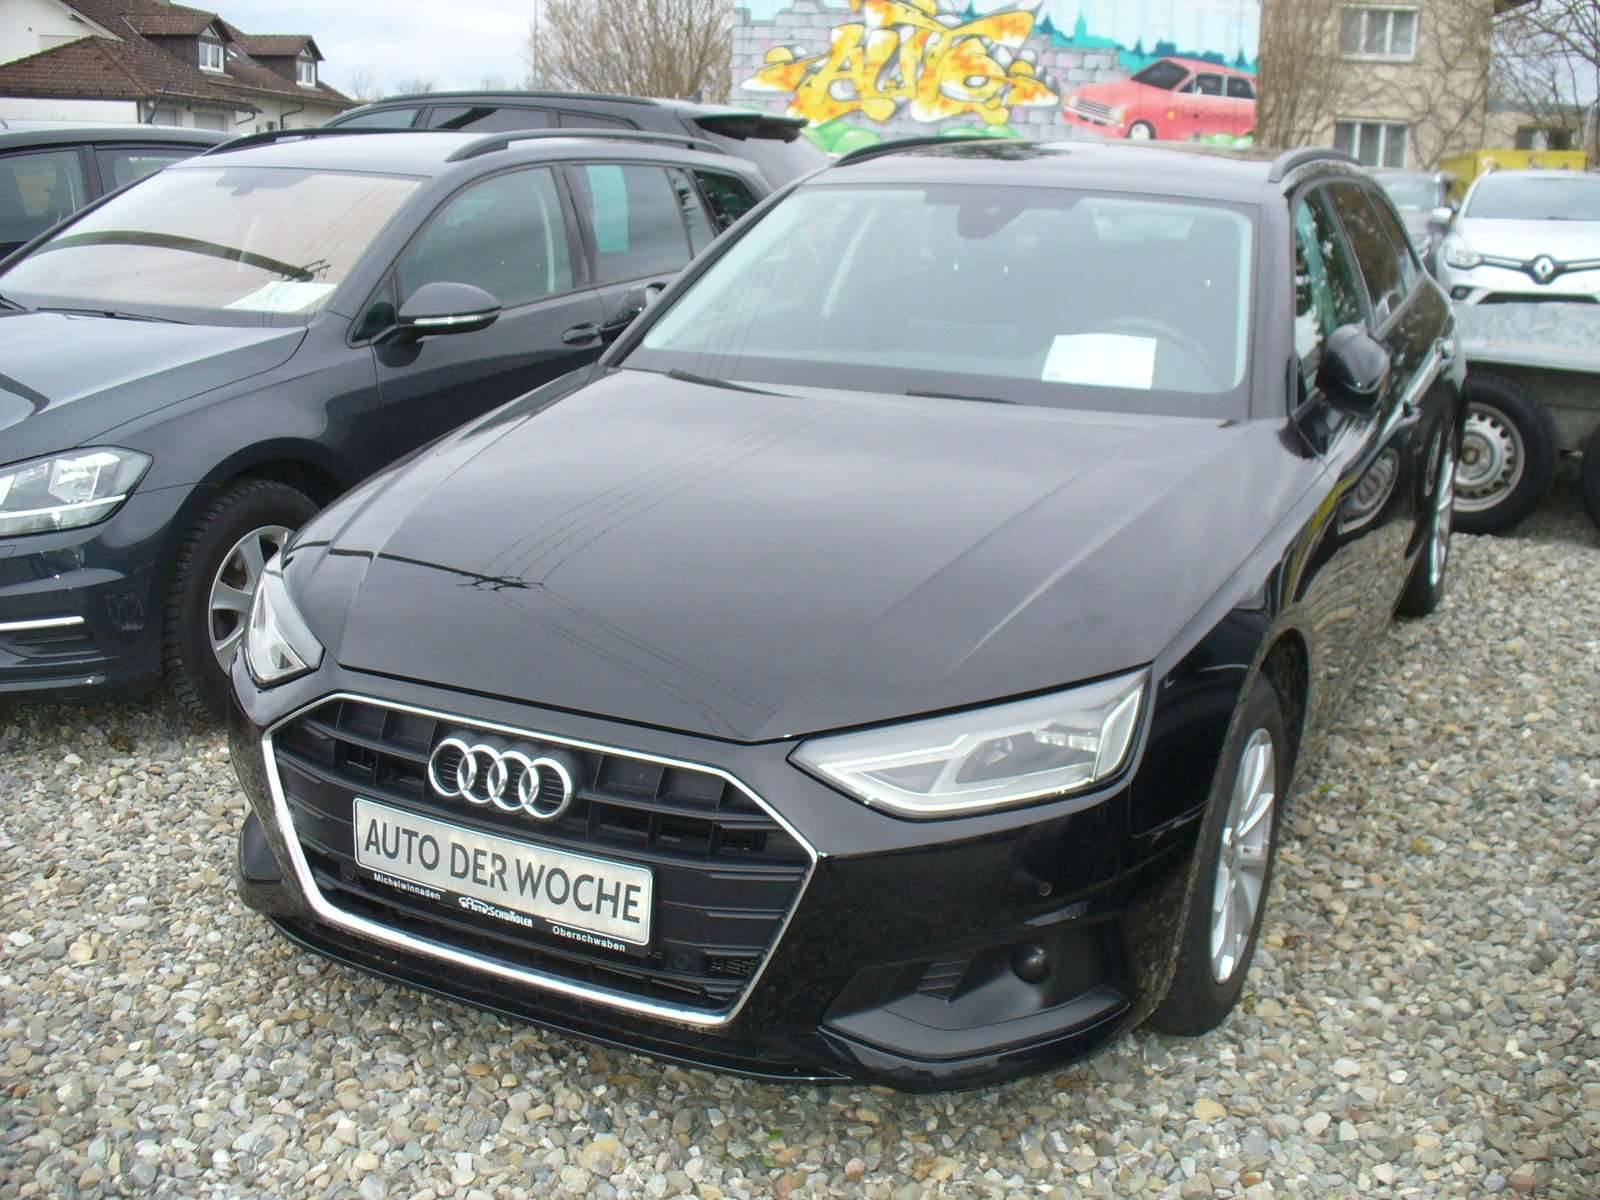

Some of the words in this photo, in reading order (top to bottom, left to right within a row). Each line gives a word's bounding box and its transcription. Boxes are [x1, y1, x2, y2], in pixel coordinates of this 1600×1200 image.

[364, 818, 440, 871] AUTO
[450, 843, 509, 892] DER
[515, 857, 642, 924] WOCHE
[373, 872, 441, 901] Michelwinnaden
[552, 925, 626, 953] Oberschwaben
